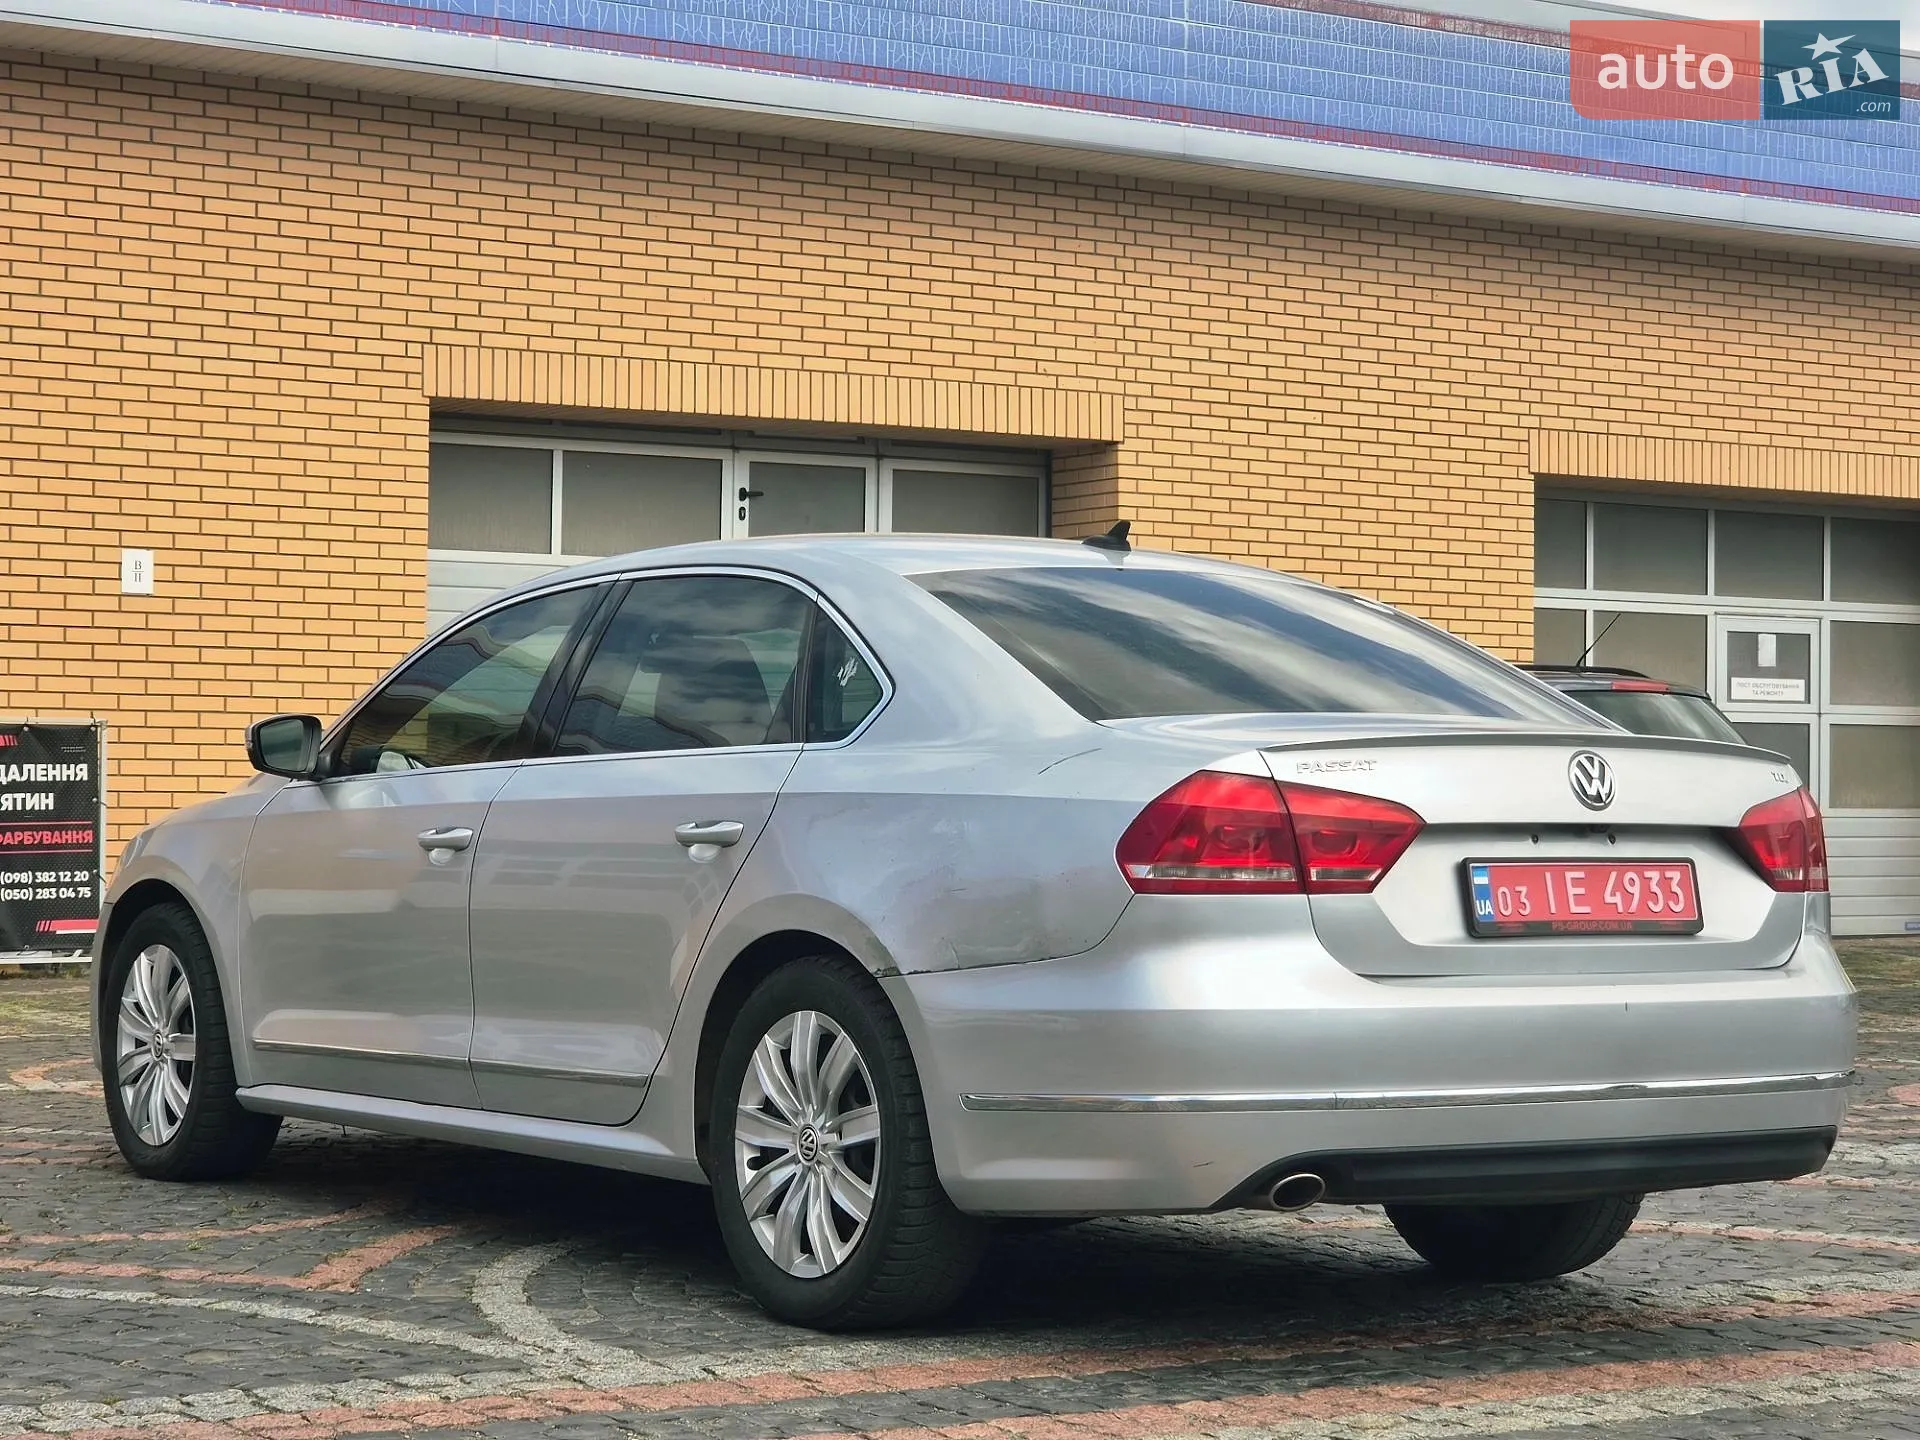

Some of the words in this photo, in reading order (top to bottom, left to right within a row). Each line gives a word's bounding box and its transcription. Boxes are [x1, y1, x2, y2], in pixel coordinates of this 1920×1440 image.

[1296, 759, 1377, 774] PASSAT
[0, 830, 93, 845] АРБУВАННЯ
[0, 870, 32, 884] (098)
[35, 871, 56, 883] 382
[58, 871, 72, 882] 12
[74, 870, 89, 882] 20
[0, 887, 33, 901] (050)
[35, 888, 57, 899] 283
[59, 887, 75, 898] 04
[78, 886, 92, 898] 75
[1476, 900, 1494, 916] UA
[1497, 886, 1531, 917] 03
[1544, 871, 1592, 914] IE
[1603, 871, 1686, 914] 4933
